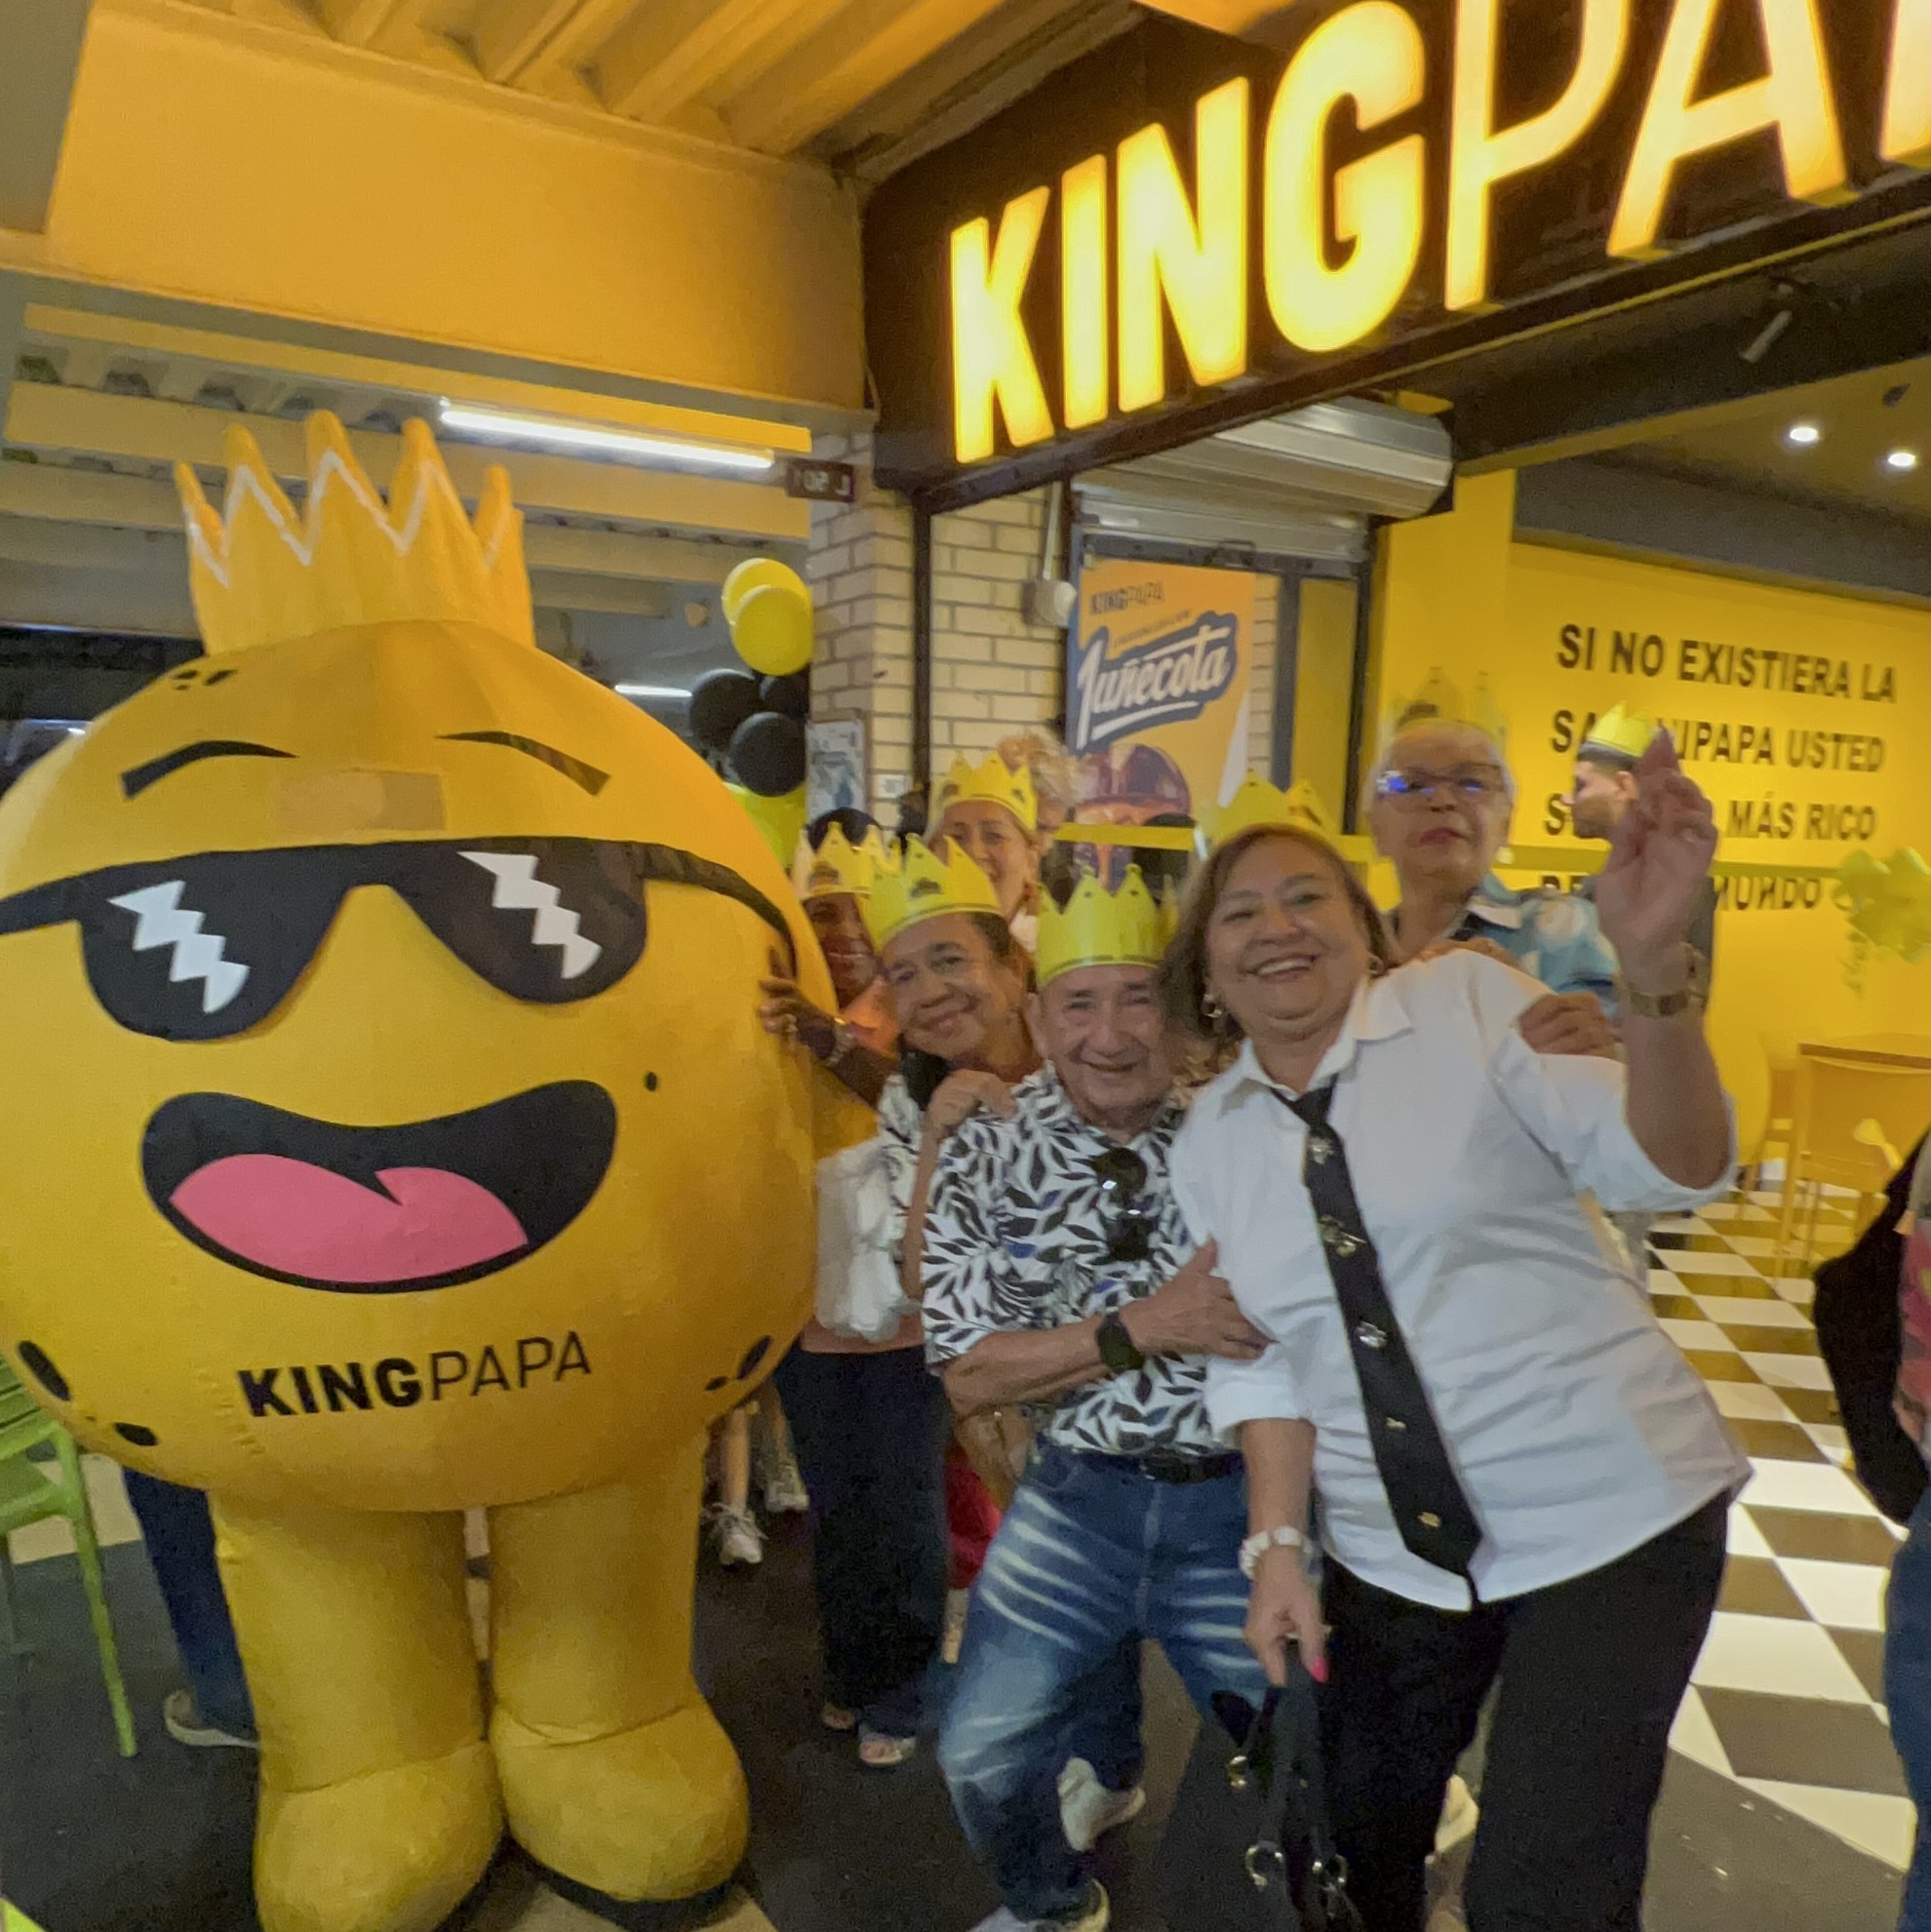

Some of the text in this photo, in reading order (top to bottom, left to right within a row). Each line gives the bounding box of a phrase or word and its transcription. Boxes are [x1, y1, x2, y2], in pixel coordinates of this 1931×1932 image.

[1557, 623, 1896, 703] SI NO EXISTIERA LA
[1787, 729, 1885, 772] USTED
[1726, 791, 1878, 840] MÁS RICO
[238, 1331, 591, 1417] KINGPAPA
